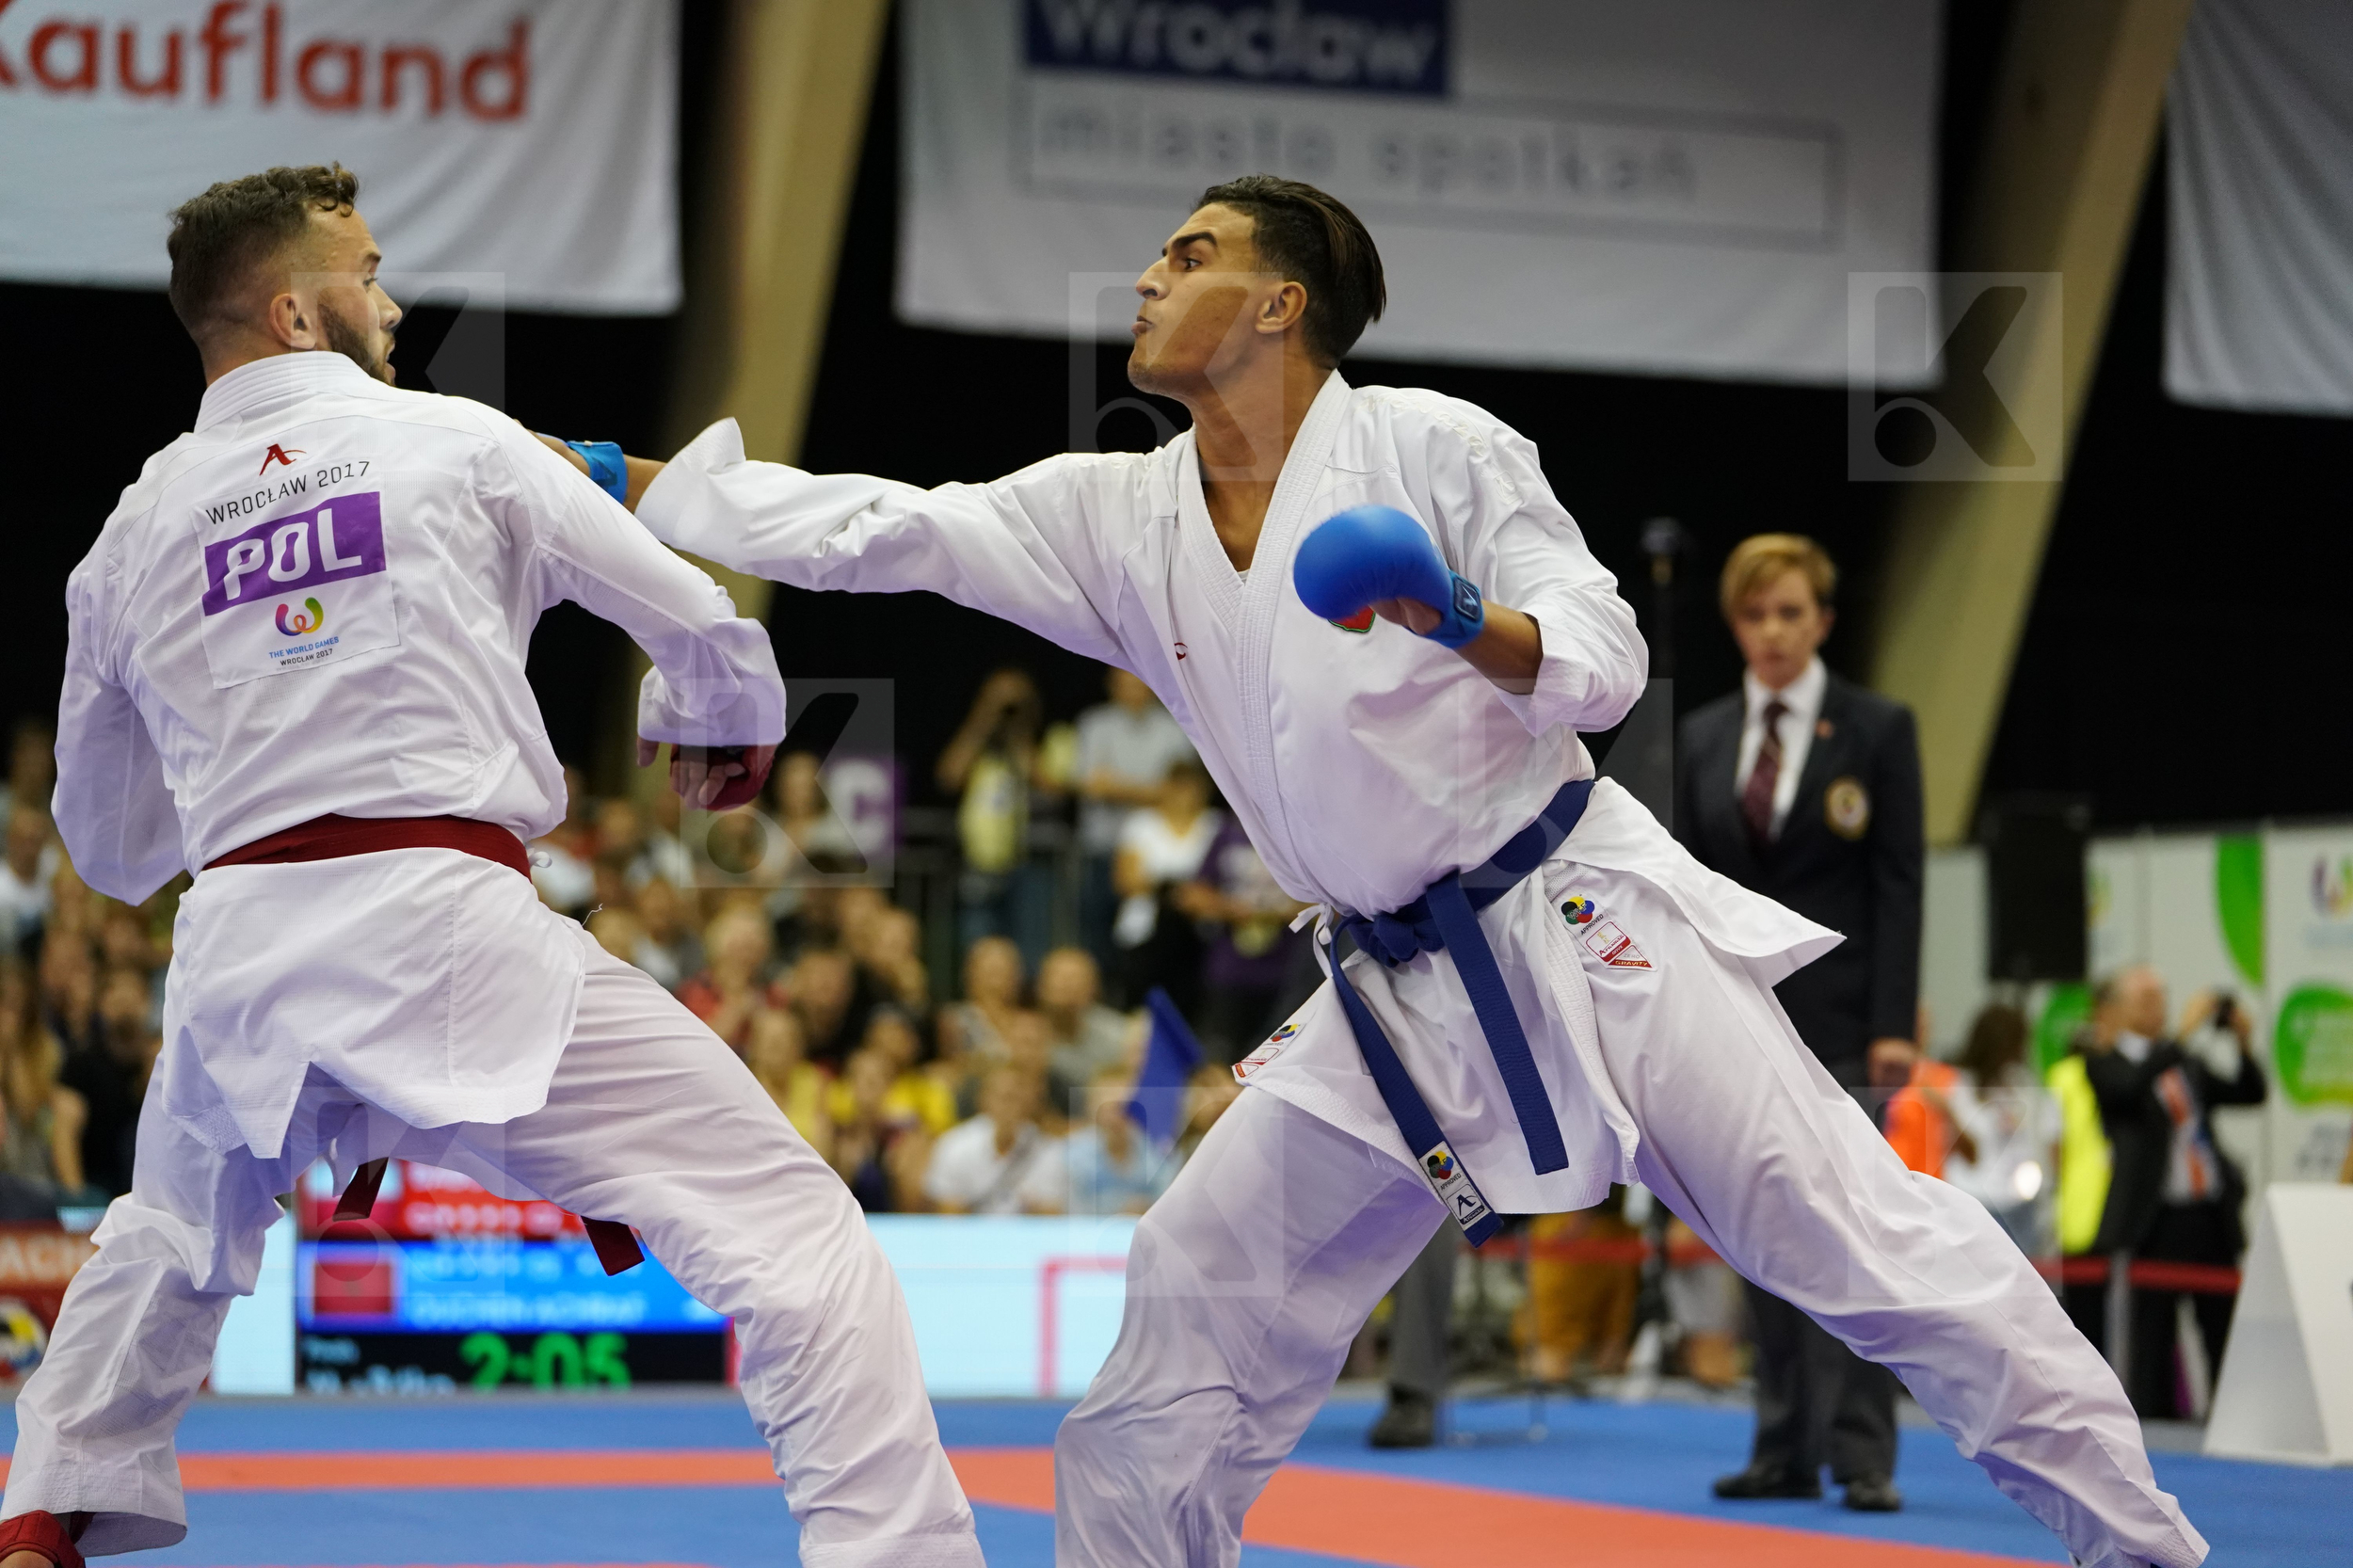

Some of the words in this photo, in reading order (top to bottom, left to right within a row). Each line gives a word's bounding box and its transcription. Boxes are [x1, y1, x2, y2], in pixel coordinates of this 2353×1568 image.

[205, 474, 307, 525] WROCŁAW
[316, 460, 370, 488] 2017
[223, 507, 362, 601] POL
[269, 649, 285, 659] THE
[285, 643, 314, 656] WORLD
[314, 636, 340, 649] GAMES
[315, 648, 333, 659] 2017
[1580, 913, 1605, 936] APPROVED
[1440, 1173, 1462, 1191] APPROVED
